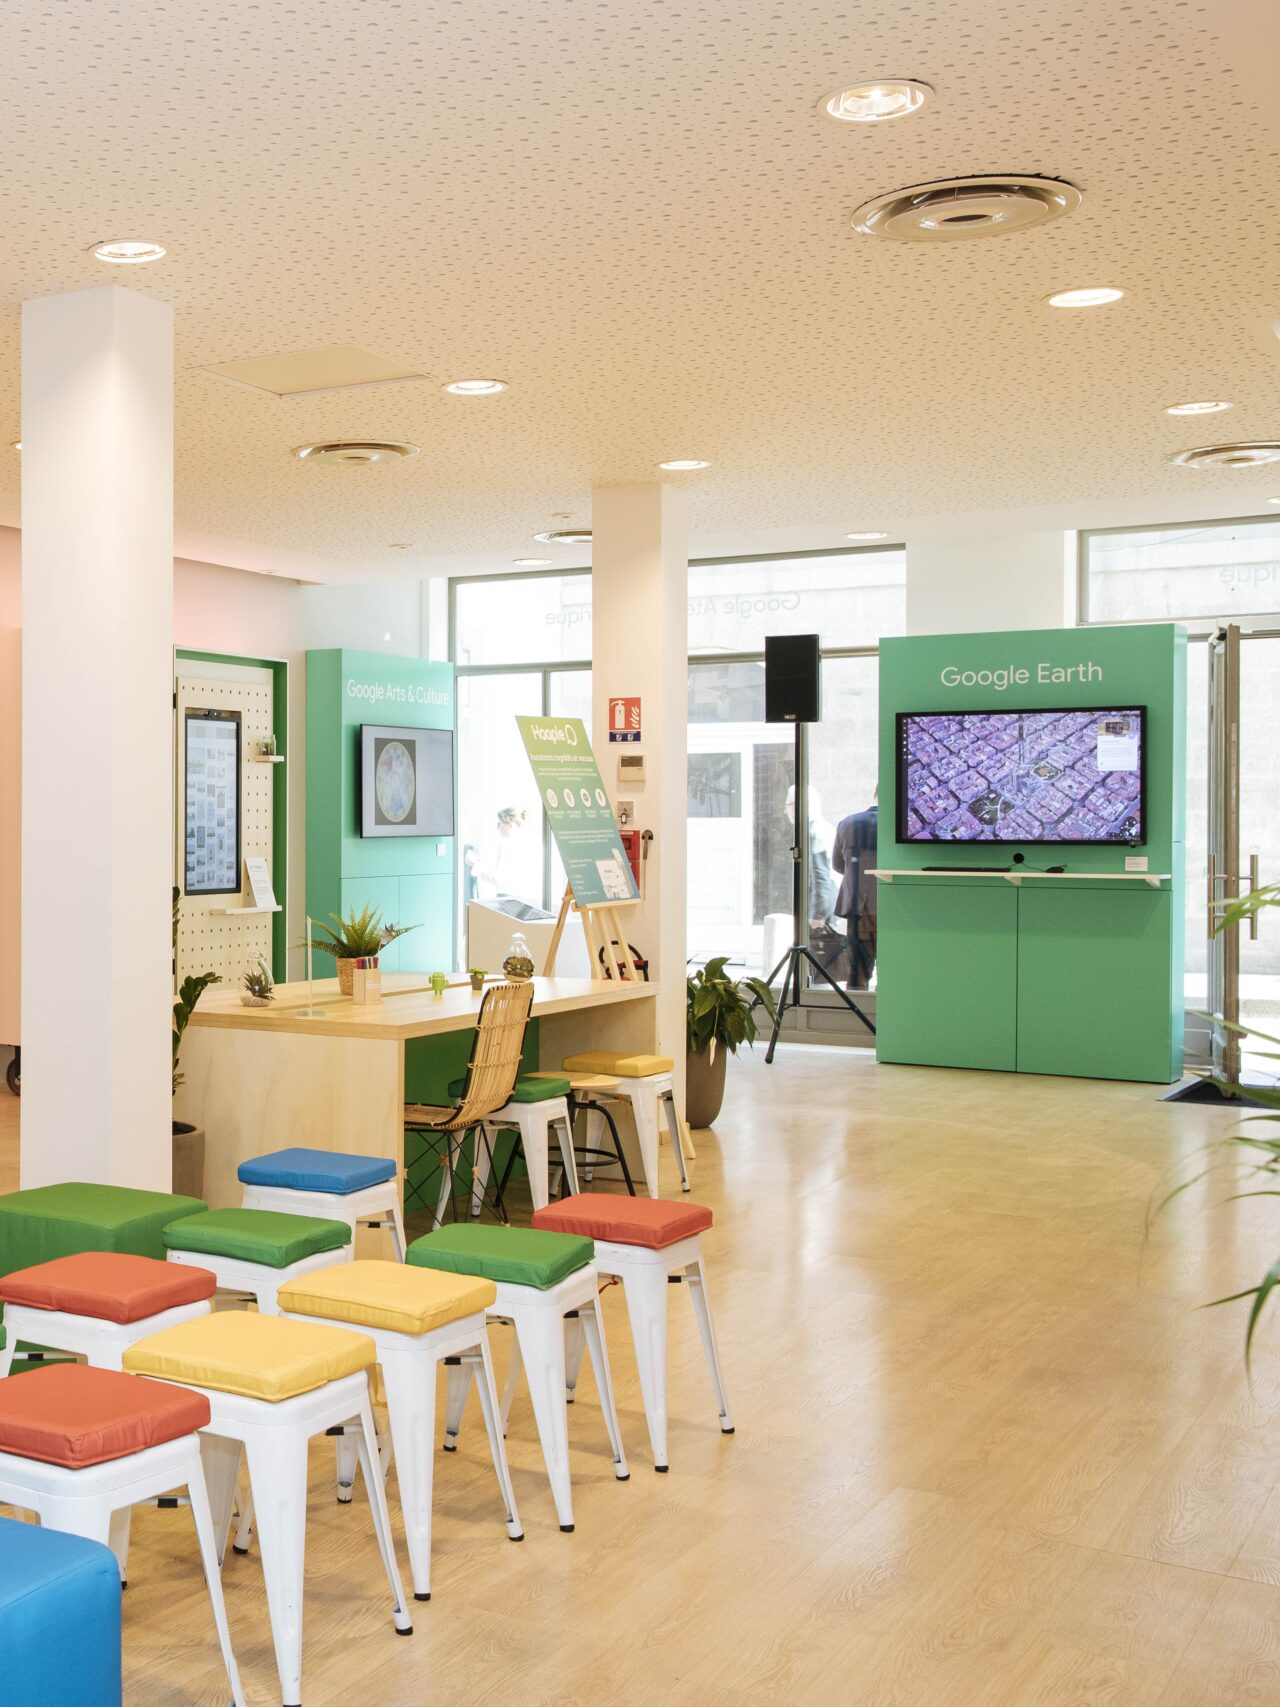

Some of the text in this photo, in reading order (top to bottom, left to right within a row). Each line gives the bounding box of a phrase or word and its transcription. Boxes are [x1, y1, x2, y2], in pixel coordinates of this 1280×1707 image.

[940, 662, 1103, 691] Google Earth
[347, 679, 449, 705] Google Arts & Culture
